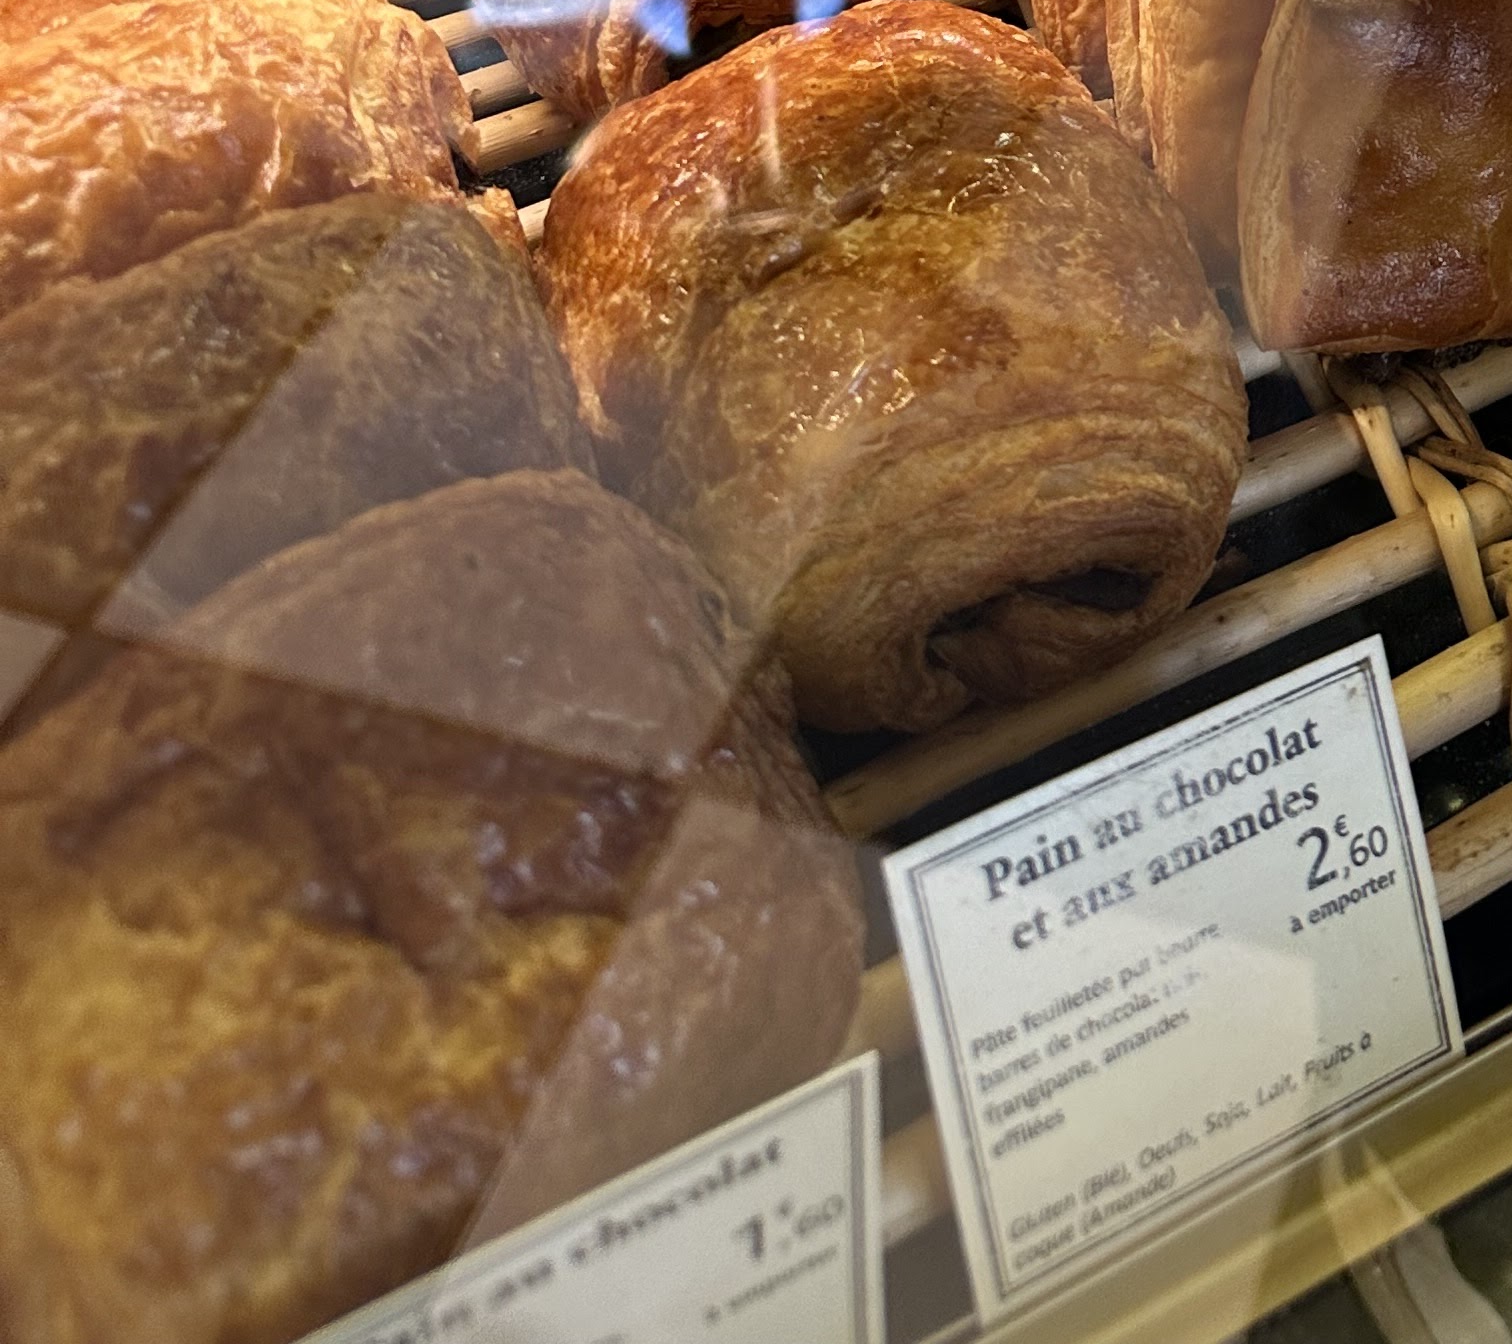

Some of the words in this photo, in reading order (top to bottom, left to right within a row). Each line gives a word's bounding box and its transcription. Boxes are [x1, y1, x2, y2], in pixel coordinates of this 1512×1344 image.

[981, 833, 1084, 903] Pain
[1093, 808, 1145, 850] au
[1155, 717, 1323, 820] chocolat
[1012, 908, 1050, 950] et
[1061, 868, 1137, 928] aux
[1147, 781, 1320, 886] amandes
[1308, 868, 1397, 925] emporter
[970, 1024, 1018, 1060] Pâte
[976, 1047, 1042, 1093] barres
[1044, 1031, 1073, 1059] de
[1102, 1008, 1191, 1065] amandes
[1304, 1041, 1356, 1083] Fruits
